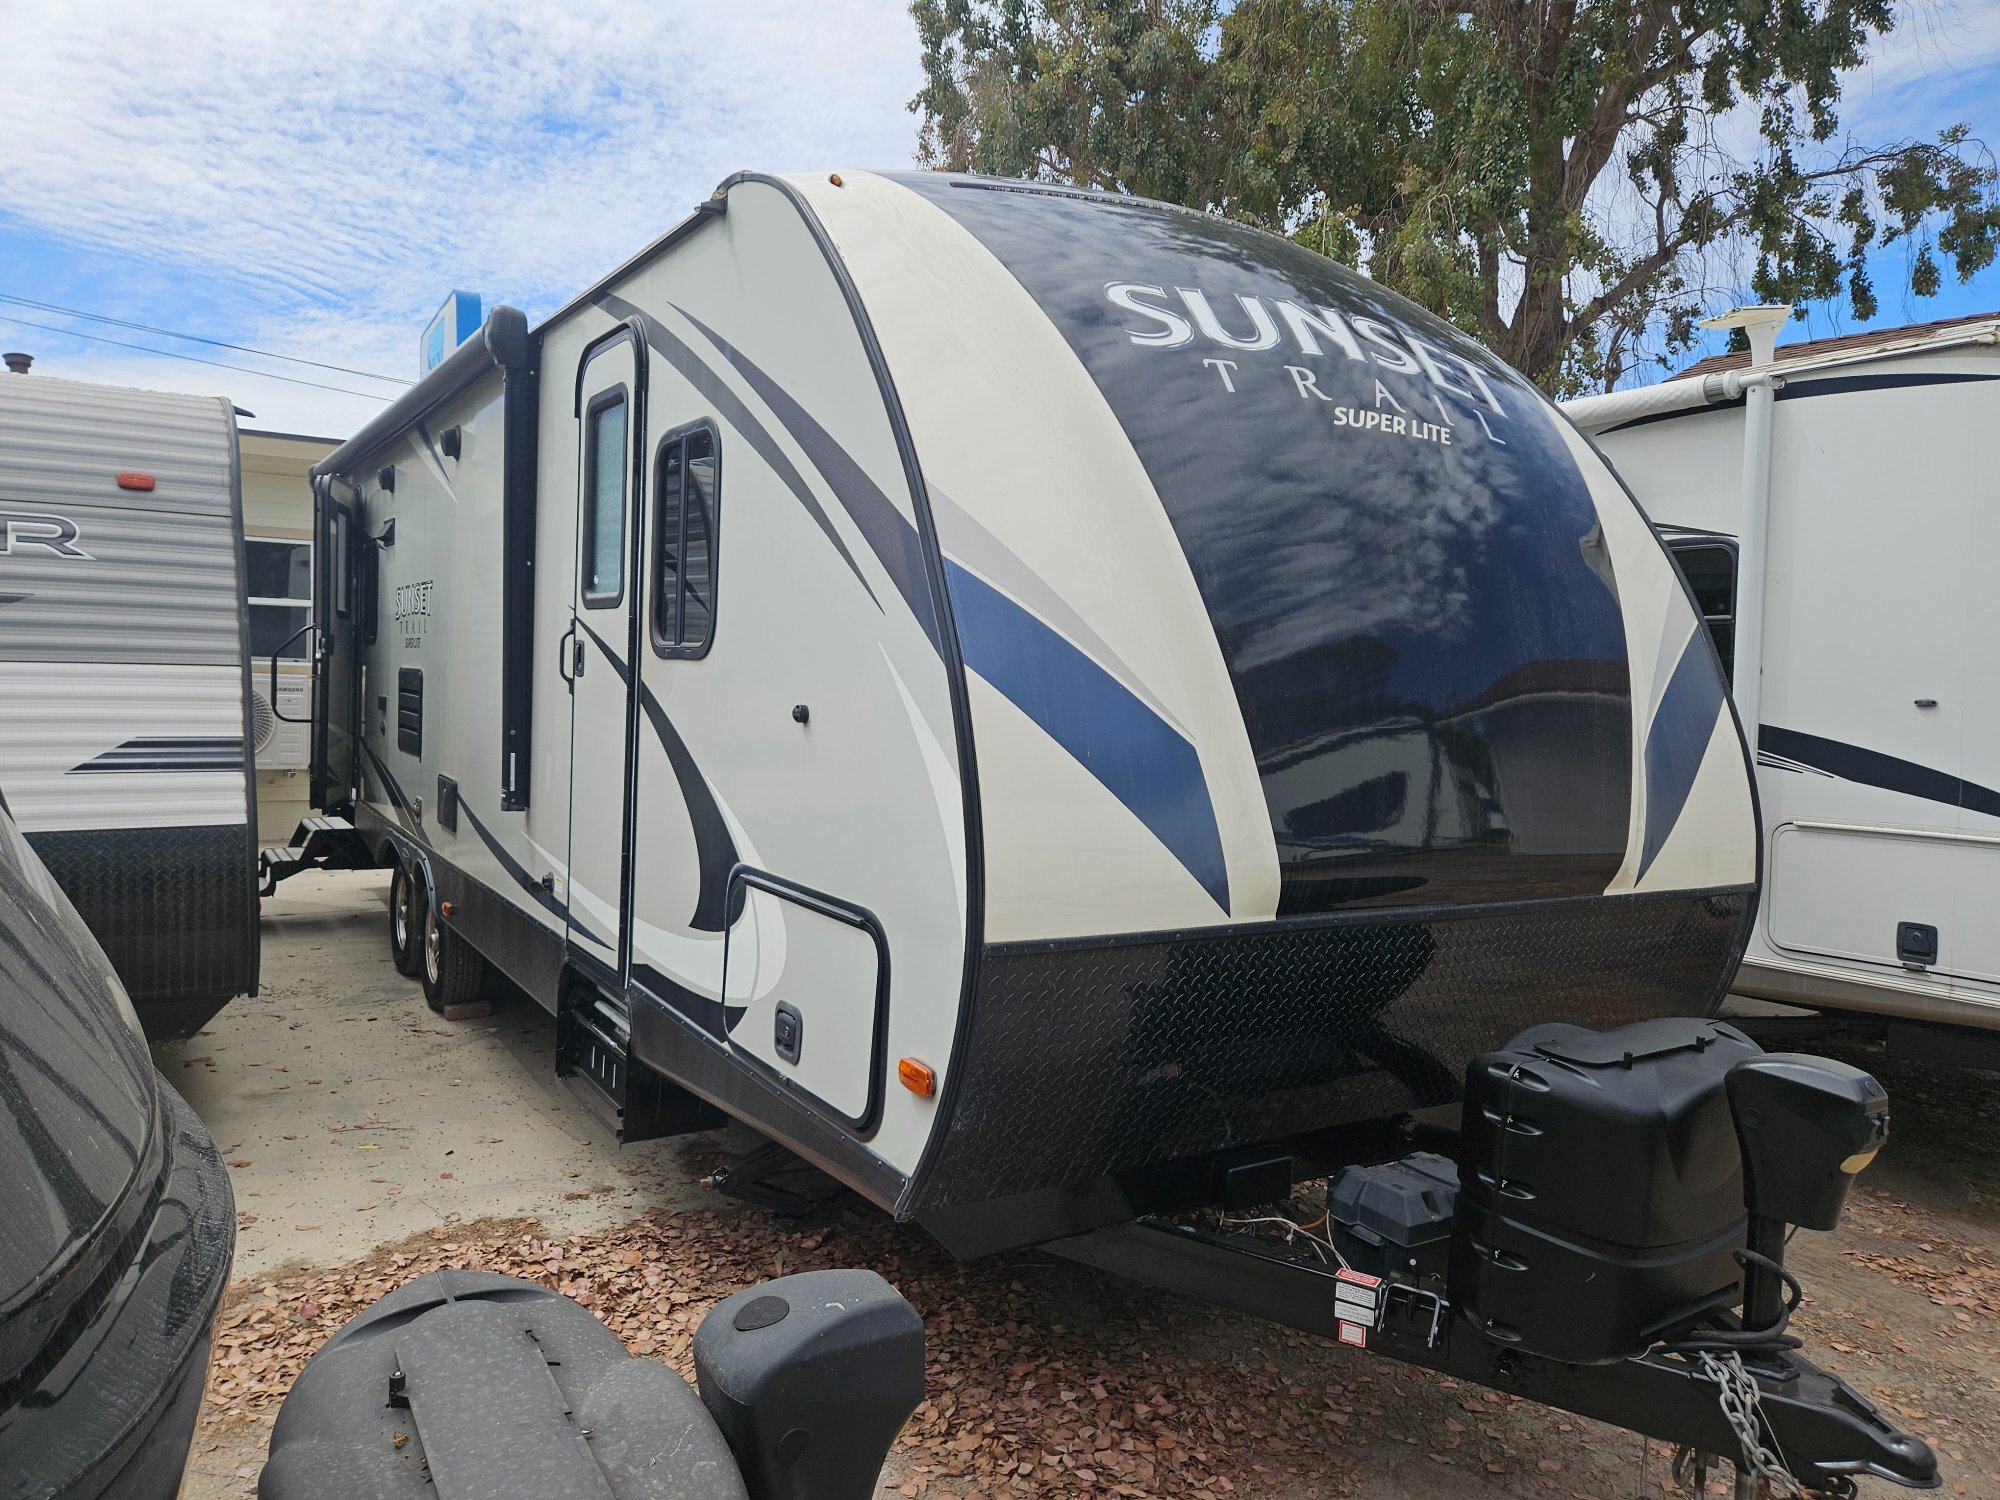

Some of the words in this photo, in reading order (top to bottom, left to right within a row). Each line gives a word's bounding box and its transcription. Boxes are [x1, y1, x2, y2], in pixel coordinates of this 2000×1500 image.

[1102, 280, 1509, 419] SUNSET
[1202, 358, 1507, 445] TRAIL
[1333, 406, 1407, 435] SUPER
[1411, 419, 1452, 446] LITE
[396, 580, 433, 620] SUNSET
[400, 618, 428, 635] TRAIL
